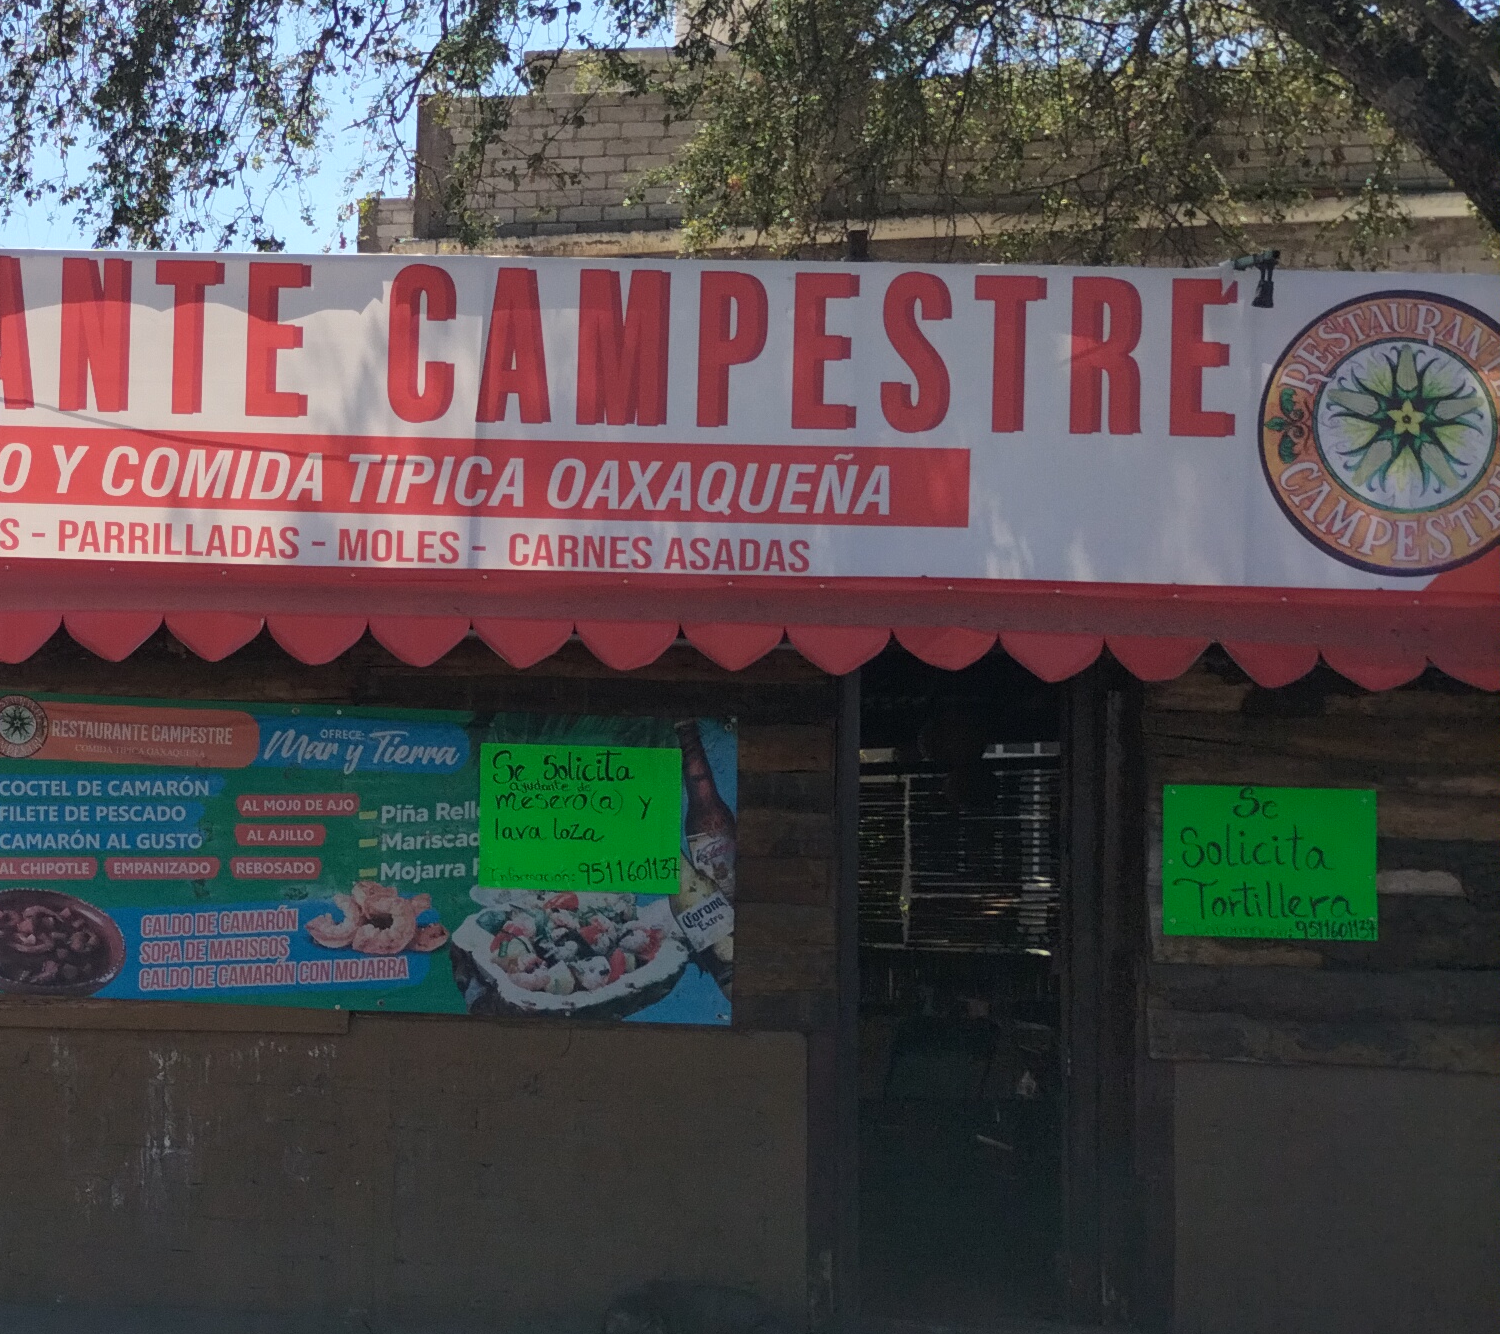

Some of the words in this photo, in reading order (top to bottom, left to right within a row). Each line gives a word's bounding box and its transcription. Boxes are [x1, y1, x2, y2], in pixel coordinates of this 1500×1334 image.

[386, 264, 1238, 437] CAMPESTRE
[53, 445, 82, 494] Y
[100, 446, 324, 503] COMIDA
[348, 454, 525, 508] TIPICA
[546, 453, 891, 517] OAXAQUEÑA
[58, 519, 299, 560] PARRILLADAS
[338, 528, 460, 563] MOLES
[508, 533, 652, 570] CARNES
[664, 537, 810, 573] ASADAS
[51, 719, 149, 742] RESTAURANTE
[151, 724, 233, 746] CAMPESTRE
[263, 728, 340, 764] Mar
[343, 744, 364, 775] y
[369, 730, 461, 765] Tierra
[492, 750, 525, 784] Se
[77, 780, 102, 796] DE
[107, 776, 209, 797] CAMARÓN
[509, 780, 569, 792] ayudante
[0, 805, 59, 822] FILETE
[64, 806, 90, 822] DE
[96, 806, 186, 822] PESCADO
[242, 799, 260, 811] AL
[305, 799, 322, 811] DE
[326, 799, 354, 811] AJO
[381, 803, 429, 824] Piña
[0, 829, 100, 849] CAMARÓN
[106, 833, 131, 849] AL
[136, 833, 203, 850] GUSTO
[246, 829, 264, 841] AL
[267, 829, 315, 842] AJILLO
[495, 818, 547, 841] lava
[553, 818, 605, 842] loza
[1180, 824, 1334, 871] Solicita
[0, 862, 18, 875] AL
[20, 862, 90, 875] CHIPOTLE
[113, 862, 211, 875] EMPANIZADO
[236, 861, 316, 875] REBOSADO
[380, 861, 467, 884] Mojarra
[578, 857, 680, 885] 9511601137
[1173, 877, 1358, 920] Tortillera
[141, 913, 193, 938] CALDO
[195, 912, 218, 935] DE
[219, 905, 298, 934] CAMARÓN
[682, 897, 728, 929] Corona
[696, 913, 725, 931] Extra
[140, 940, 181, 964] SOPA
[184, 939, 207, 961] DE
[209, 936, 290, 960] MARISCOS
[139, 967, 192, 990] CALDO
[193, 966, 216, 988] DE
[217, 958, 296, 987] CAMARÓN
[299, 961, 331, 983] CON
[333, 955, 409, 982] MOJARRA
